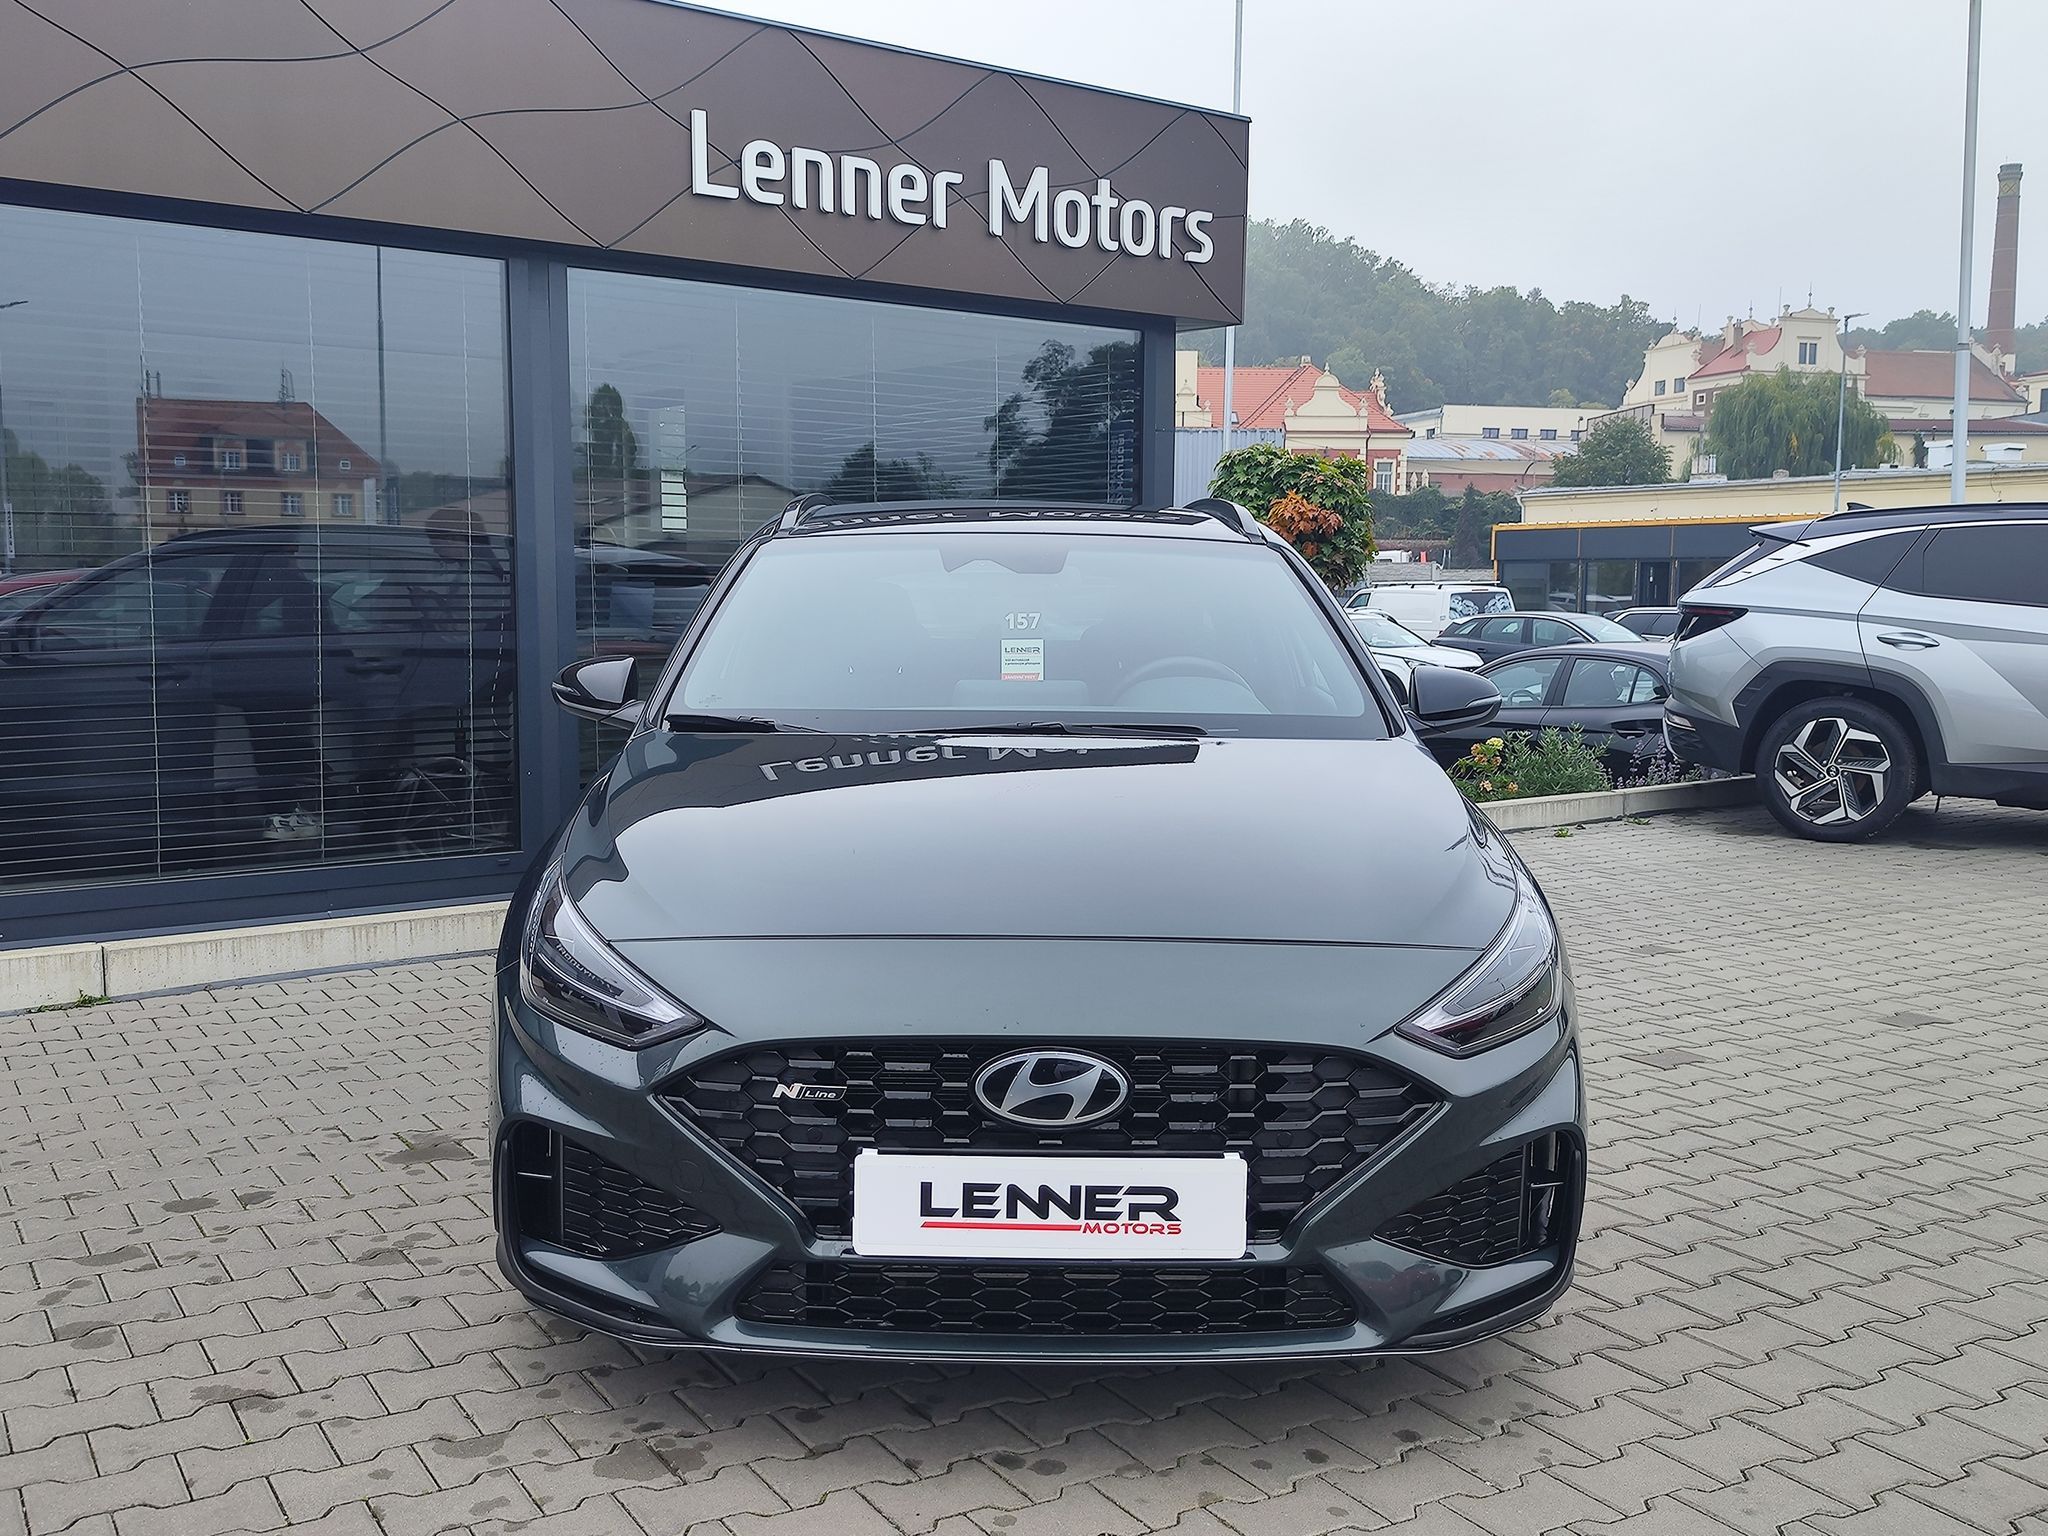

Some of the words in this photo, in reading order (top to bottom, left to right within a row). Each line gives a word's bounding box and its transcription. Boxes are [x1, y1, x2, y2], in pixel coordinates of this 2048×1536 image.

[690, 108, 964, 231] Lenner
[987, 158, 1215, 264] Motors
[1005, 612, 1041, 630] 157
[1004, 646, 1041, 654] LENNER
[772, 1083, 802, 1099] N
[804, 1090, 837, 1099] Line
[920, 1181, 1182, 1222] LENNER
[1081, 1223, 1182, 1235] MOTORS
